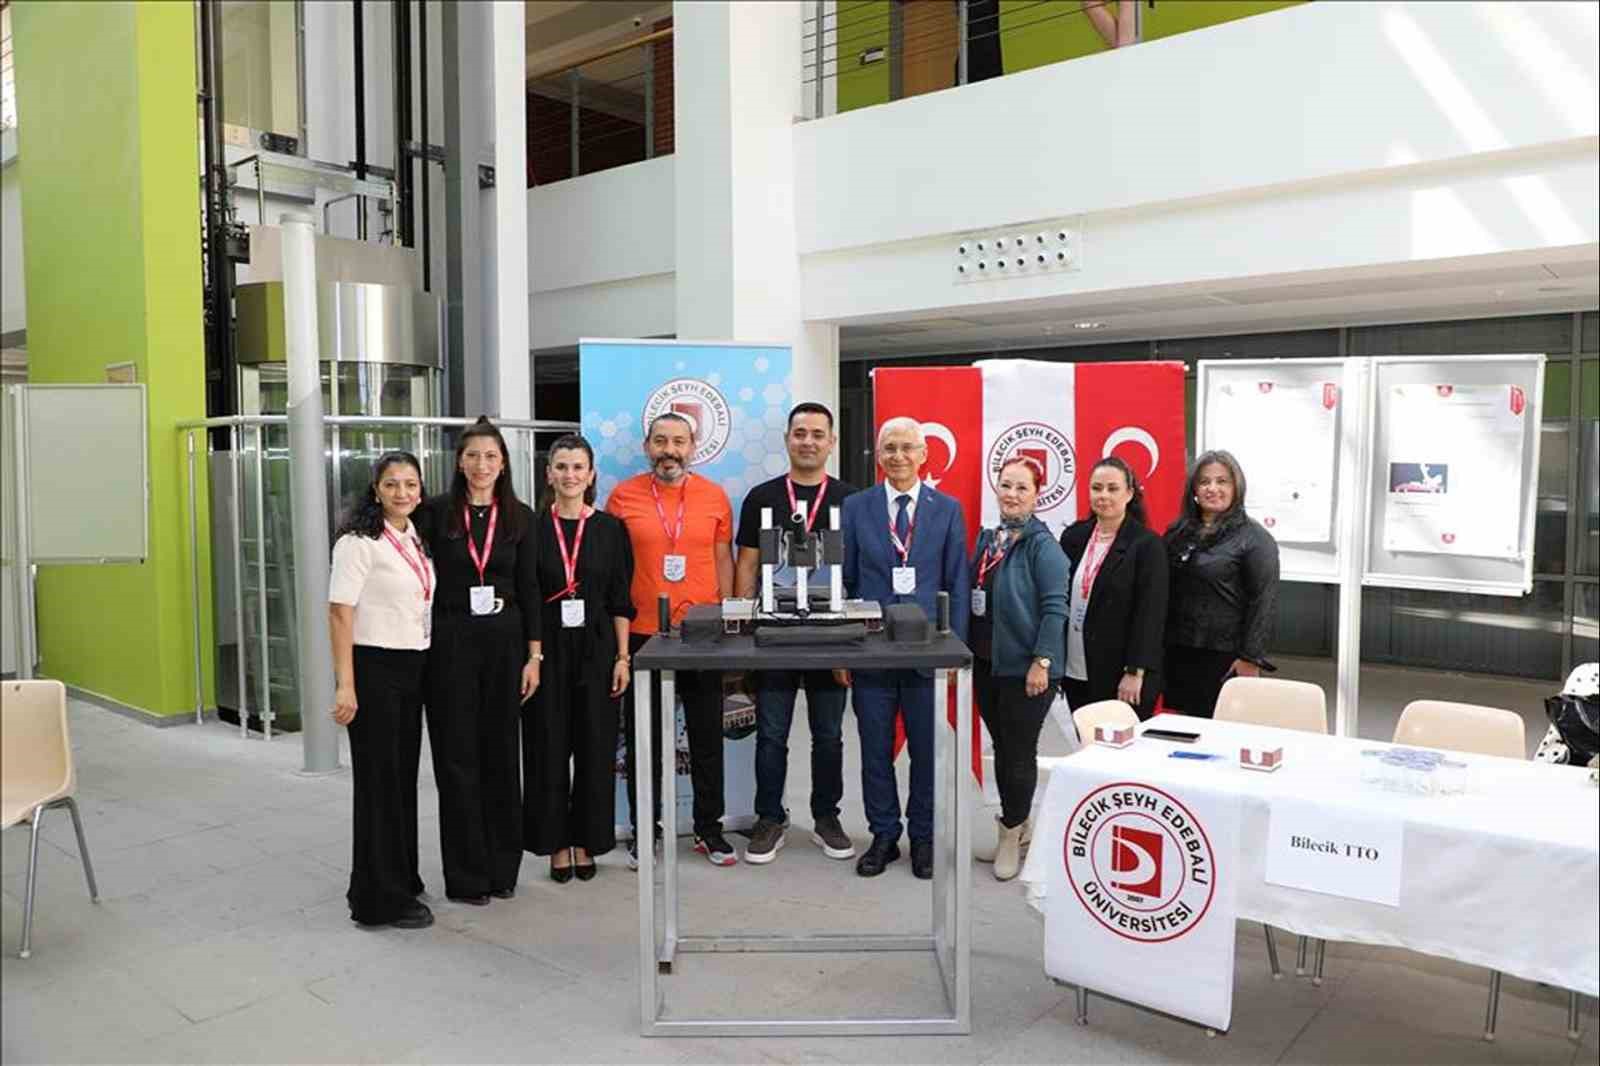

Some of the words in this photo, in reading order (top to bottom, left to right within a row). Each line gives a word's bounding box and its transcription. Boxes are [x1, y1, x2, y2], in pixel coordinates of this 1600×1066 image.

[1072, 797, 1111, 857] BİLECİK
[1112, 792, 1157, 810] ŞEYH
[1290, 835, 1338, 855] Bilecik
[1344, 843, 1379, 860] TTO
[1083, 880, 1193, 932] ÜNİVERSİTESİ
